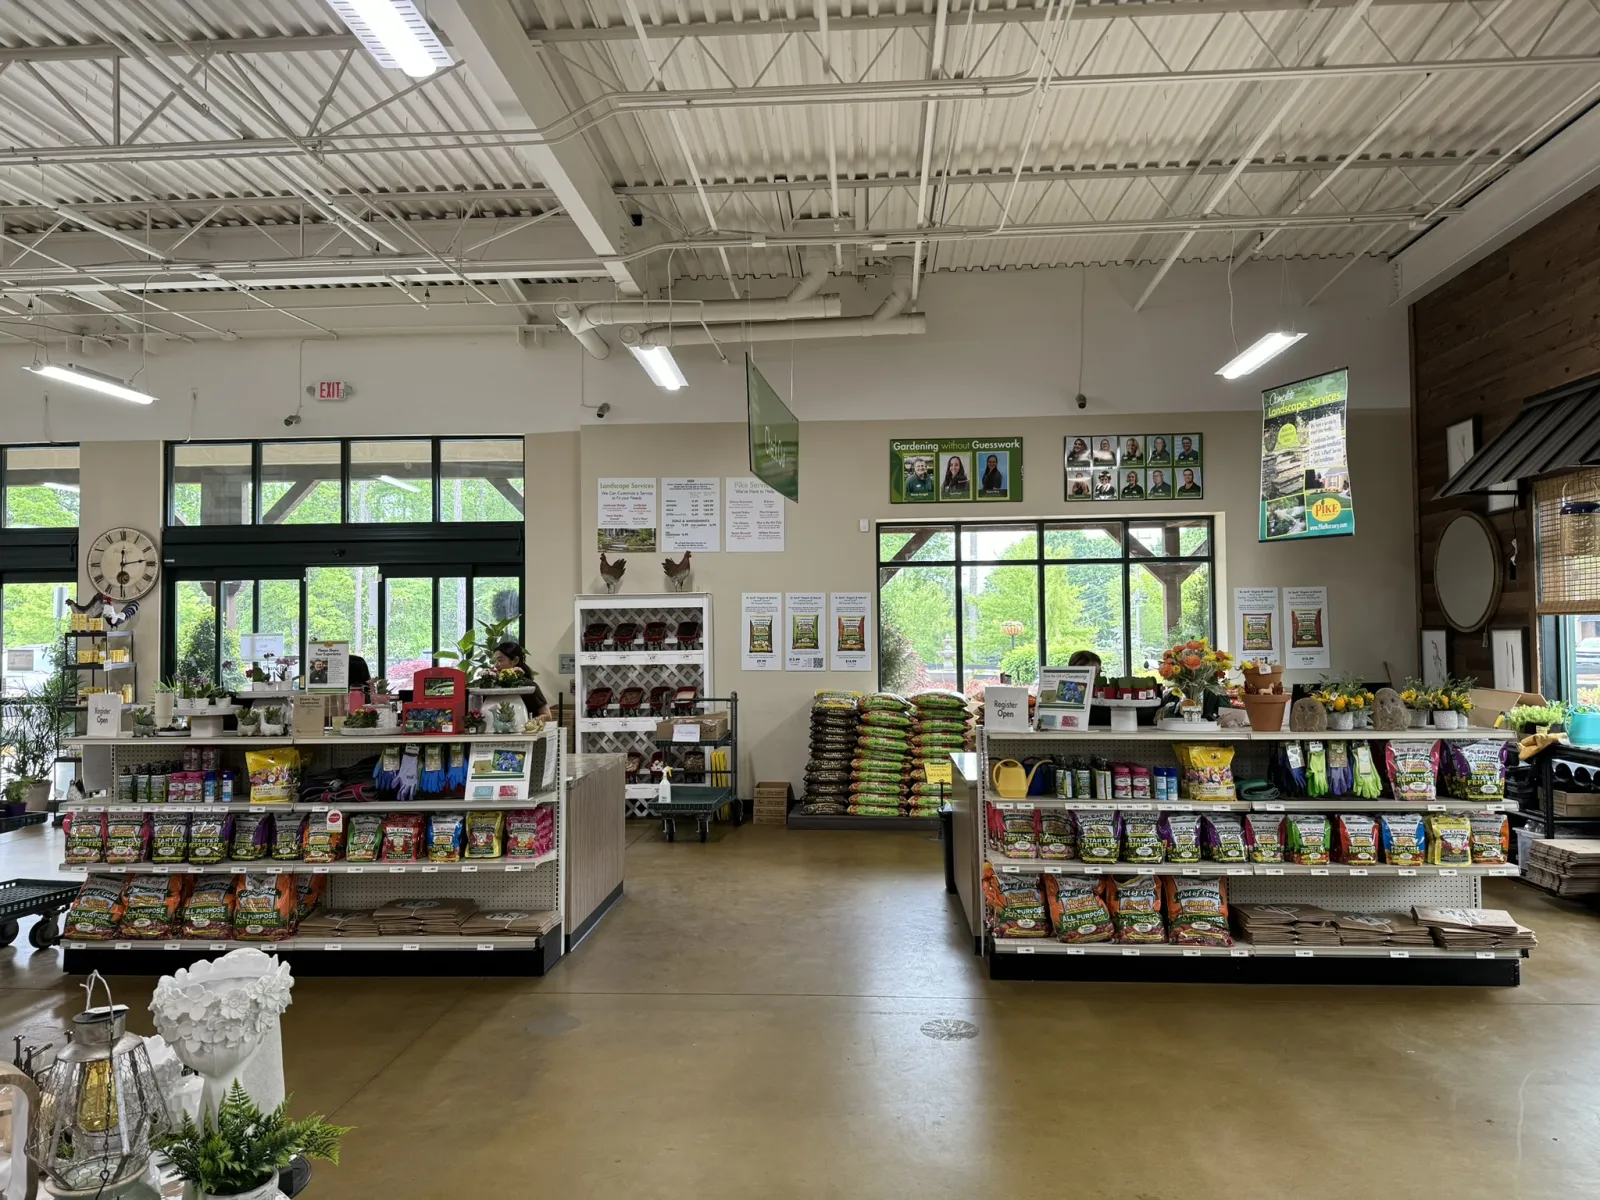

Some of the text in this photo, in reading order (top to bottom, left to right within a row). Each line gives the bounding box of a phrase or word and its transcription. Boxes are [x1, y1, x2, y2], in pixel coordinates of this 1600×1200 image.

[320, 382, 341, 398] EXIT
[1268, 392, 1341, 417] Landscape Services
[893, 439, 1020, 452] Gardening without Guesswork
[600, 482, 630, 490] Landscape
[1315, 504, 1339, 517] PIKE
[994, 700, 1018, 709] Register
[94, 707, 111, 716] Register
[997, 710, 1014, 719] Open
[97, 716, 108, 725] Open
[1076, 908, 1105, 919] PURPOSE
[1062, 915, 1108, 929] POTTING SOIL
